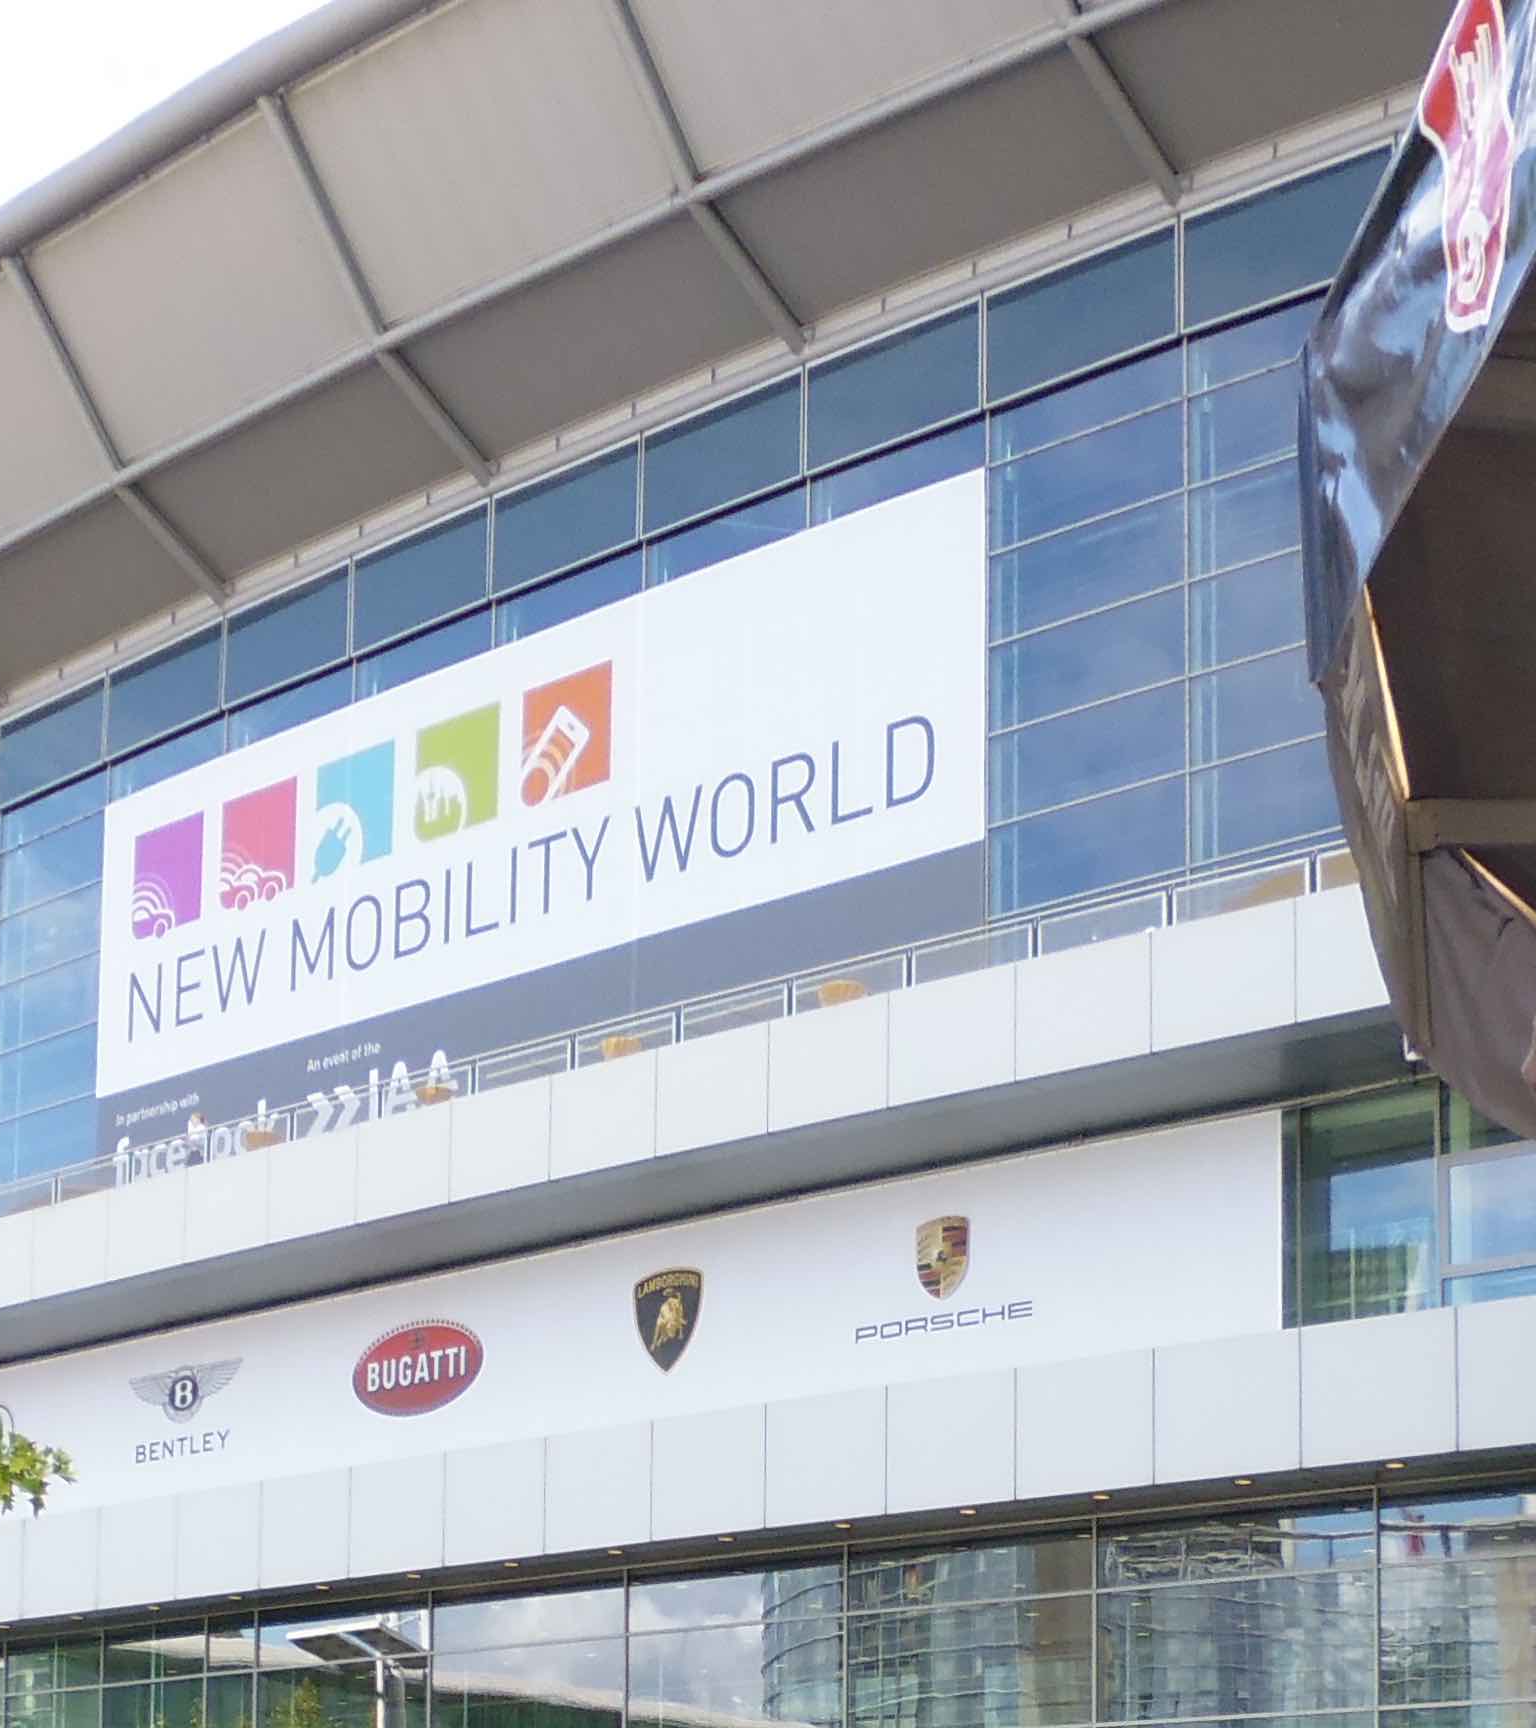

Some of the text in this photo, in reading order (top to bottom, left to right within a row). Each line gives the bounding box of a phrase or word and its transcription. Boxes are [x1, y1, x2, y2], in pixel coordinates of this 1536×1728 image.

[127, 714, 936, 1043] NEW MOBILITY WORLD
[306, 1041, 381, 1072] An event of the
[855, 1300, 1033, 1344] PORSCHE
[365, 1345, 467, 1394] BUGATTI
[134, 1428, 231, 1464] BENTLEY
